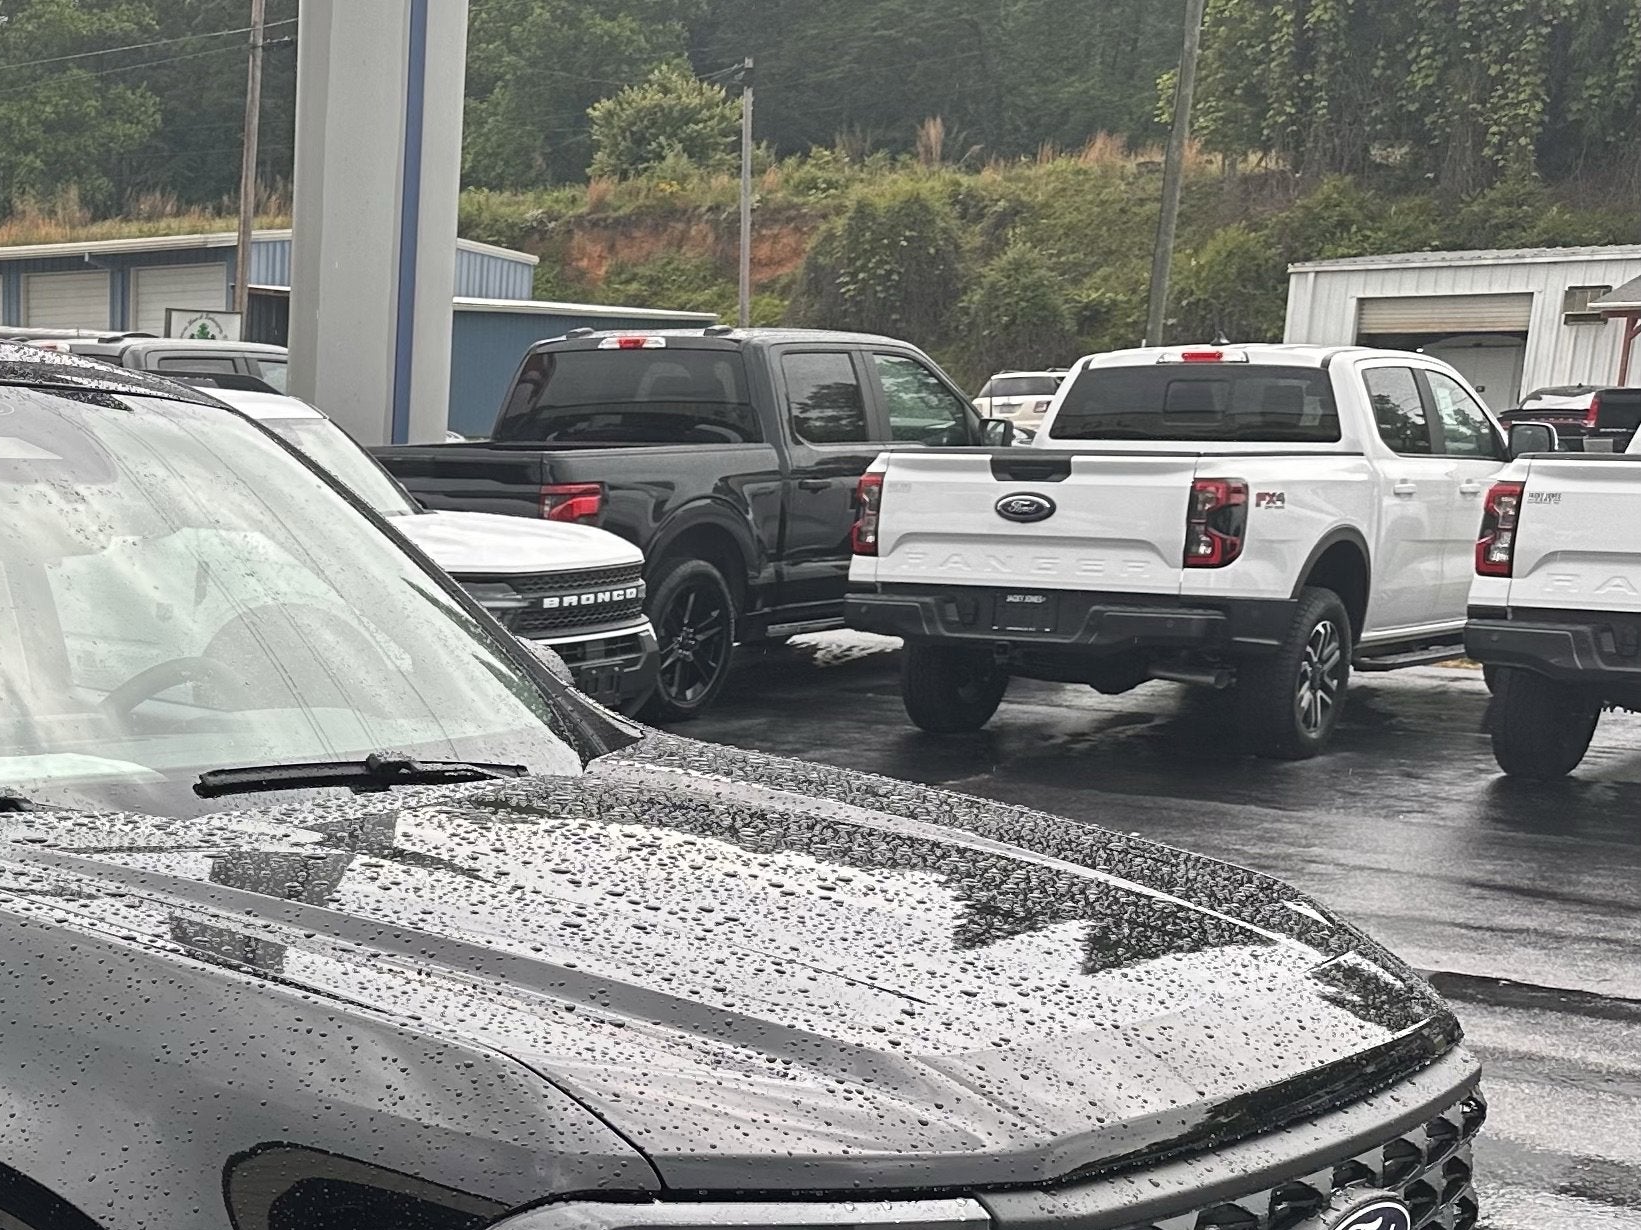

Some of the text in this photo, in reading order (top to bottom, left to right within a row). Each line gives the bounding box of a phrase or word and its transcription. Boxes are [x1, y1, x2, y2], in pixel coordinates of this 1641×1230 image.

[1007, 500, 1037, 513] Ford
[1255, 492, 1285, 508] FX4
[542, 587, 638, 609] BRONCO
